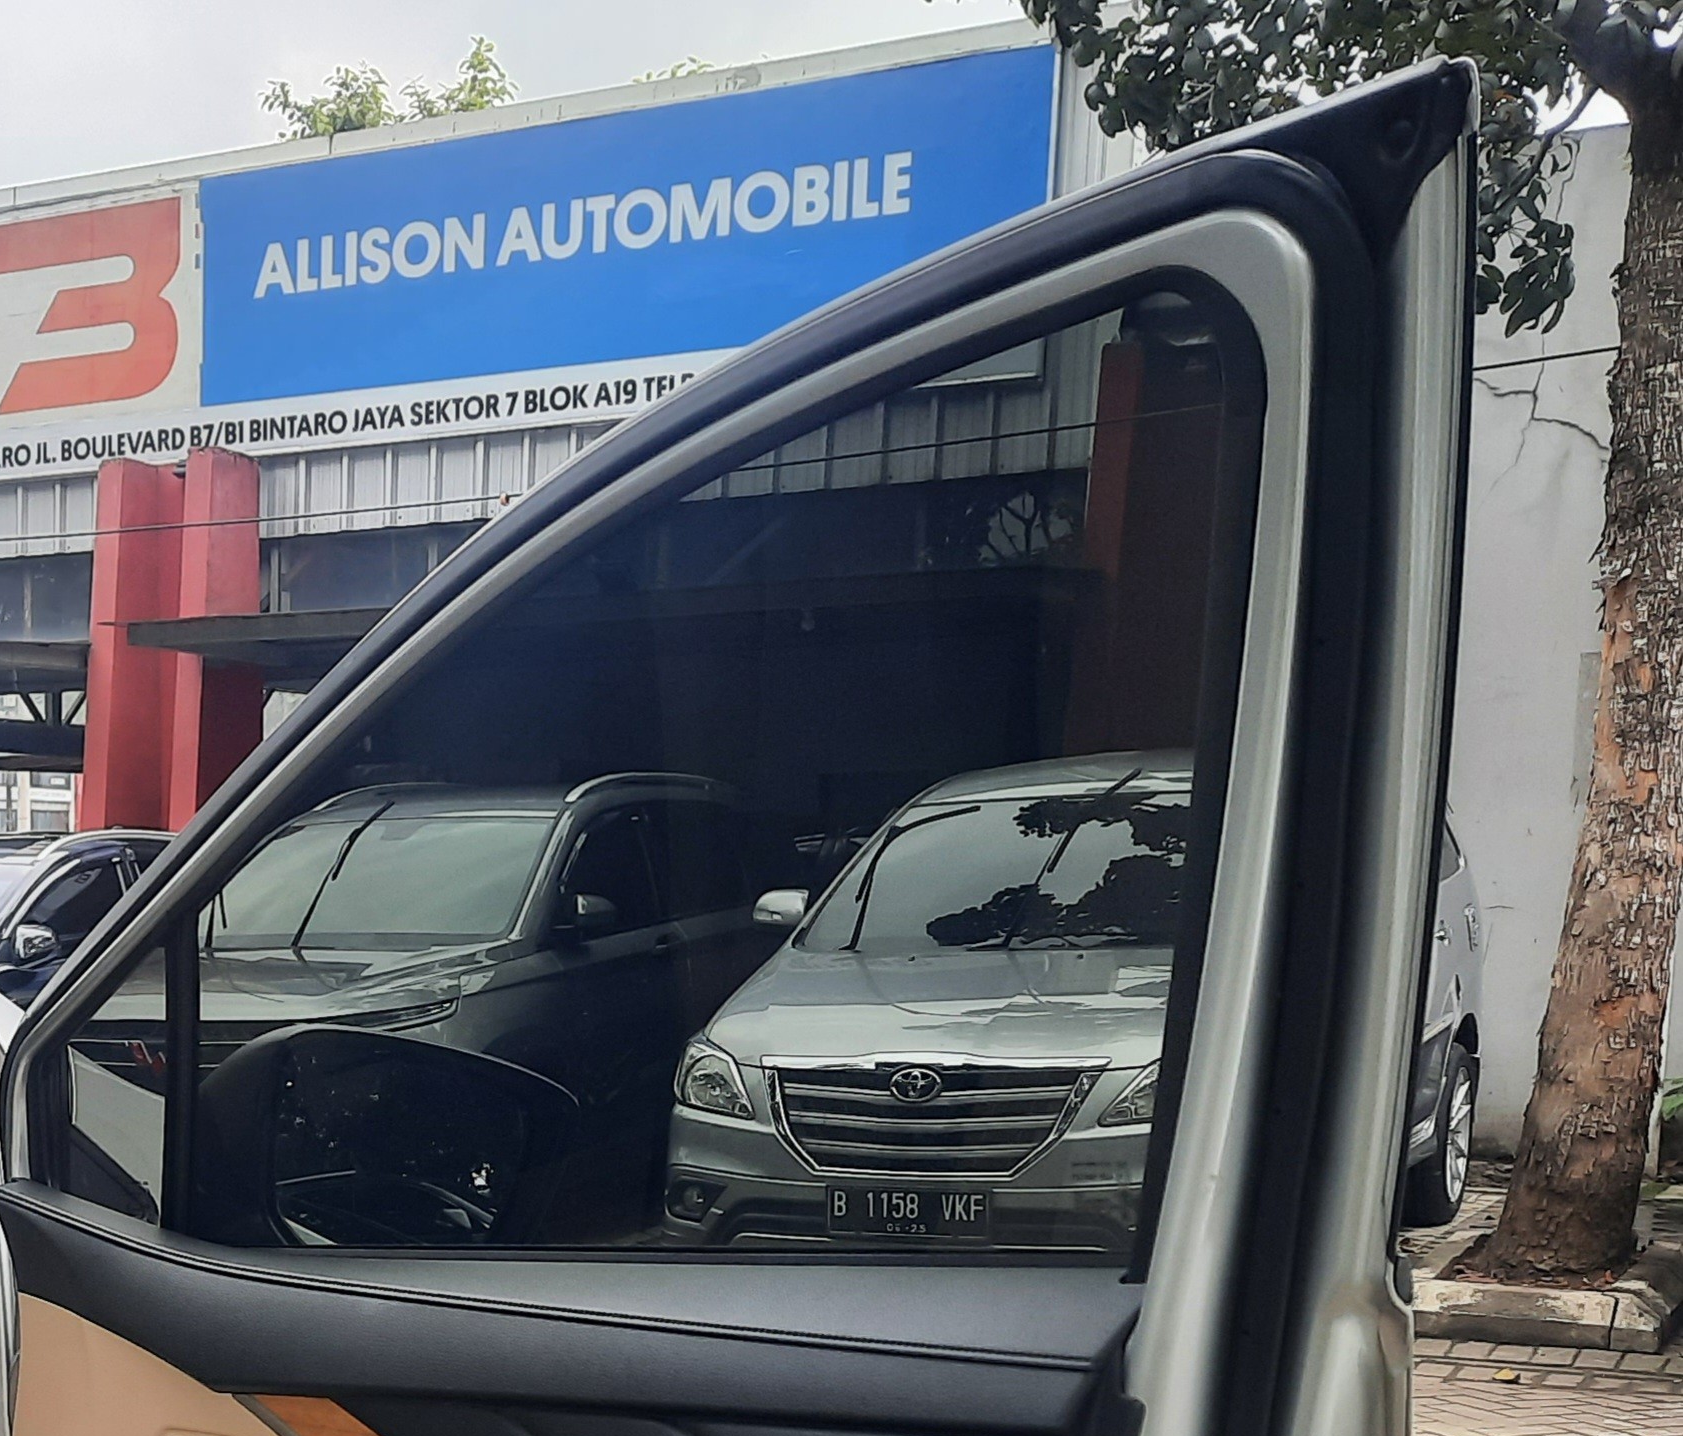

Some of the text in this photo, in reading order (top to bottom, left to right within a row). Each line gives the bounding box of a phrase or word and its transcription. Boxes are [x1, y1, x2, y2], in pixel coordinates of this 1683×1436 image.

[253, 151, 913, 299] ALLISON AUTOMOBILE
[35, 440, 57, 465] JL.
[61, 426, 186, 462] BOULEVARD
[190, 420, 244, 448] B7/B1
[249, 410, 348, 443] BINTARO
[352, 404, 405, 432] JAYA
[410, 392, 501, 427] SEKTOR
[505, 390, 518, 417] 7
[524, 383, 587, 415] BLOK
[594, 378, 637, 407] A19
[833, 1190, 984, 1222] B 1158 VKF
